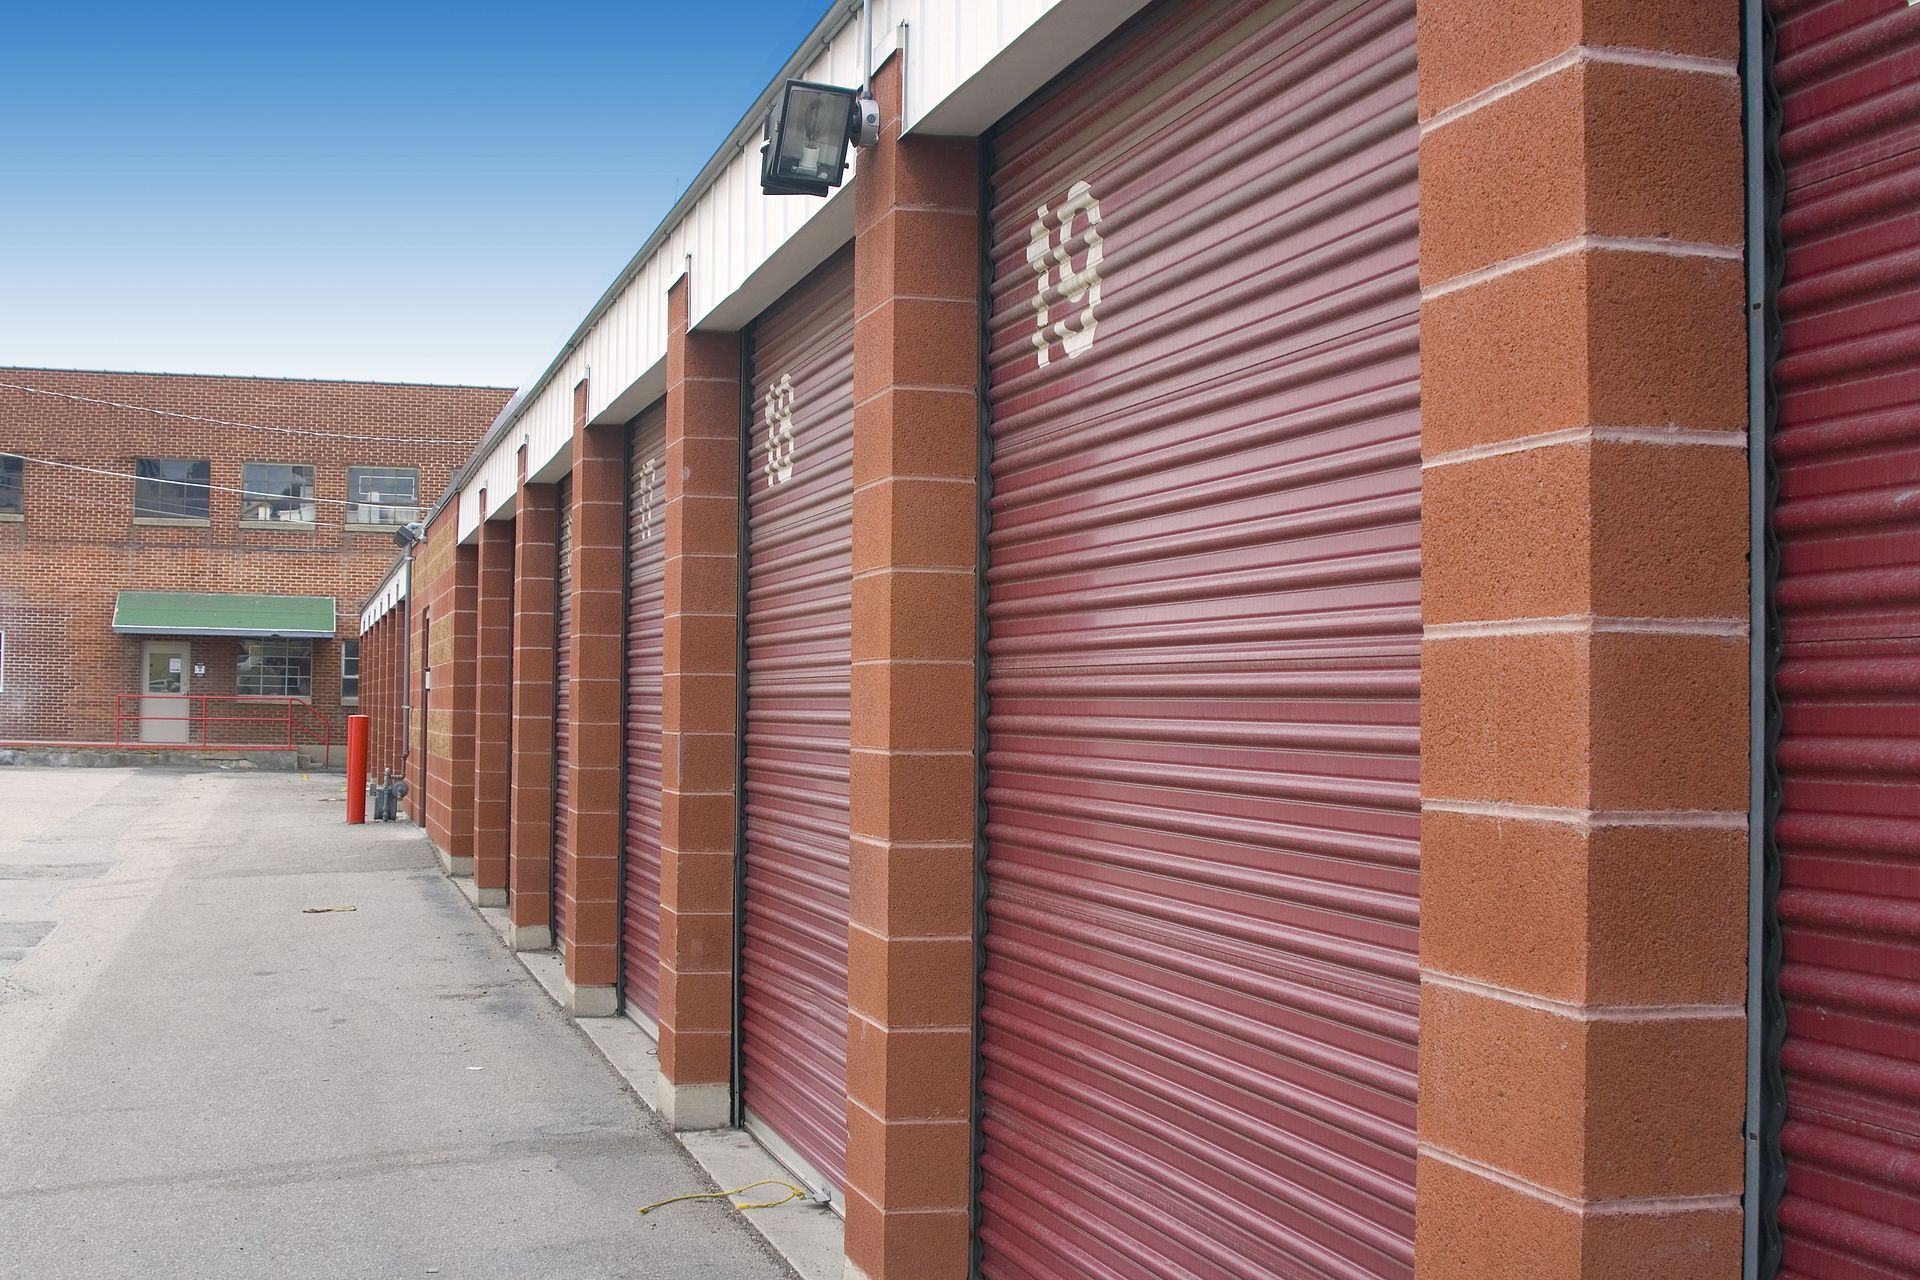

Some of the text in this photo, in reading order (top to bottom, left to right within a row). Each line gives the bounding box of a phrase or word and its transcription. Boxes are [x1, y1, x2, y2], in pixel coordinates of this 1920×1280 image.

[1027, 180, 1104, 368] 19
[765, 373, 794, 487] 18
[640, 458, 656, 539] 17
